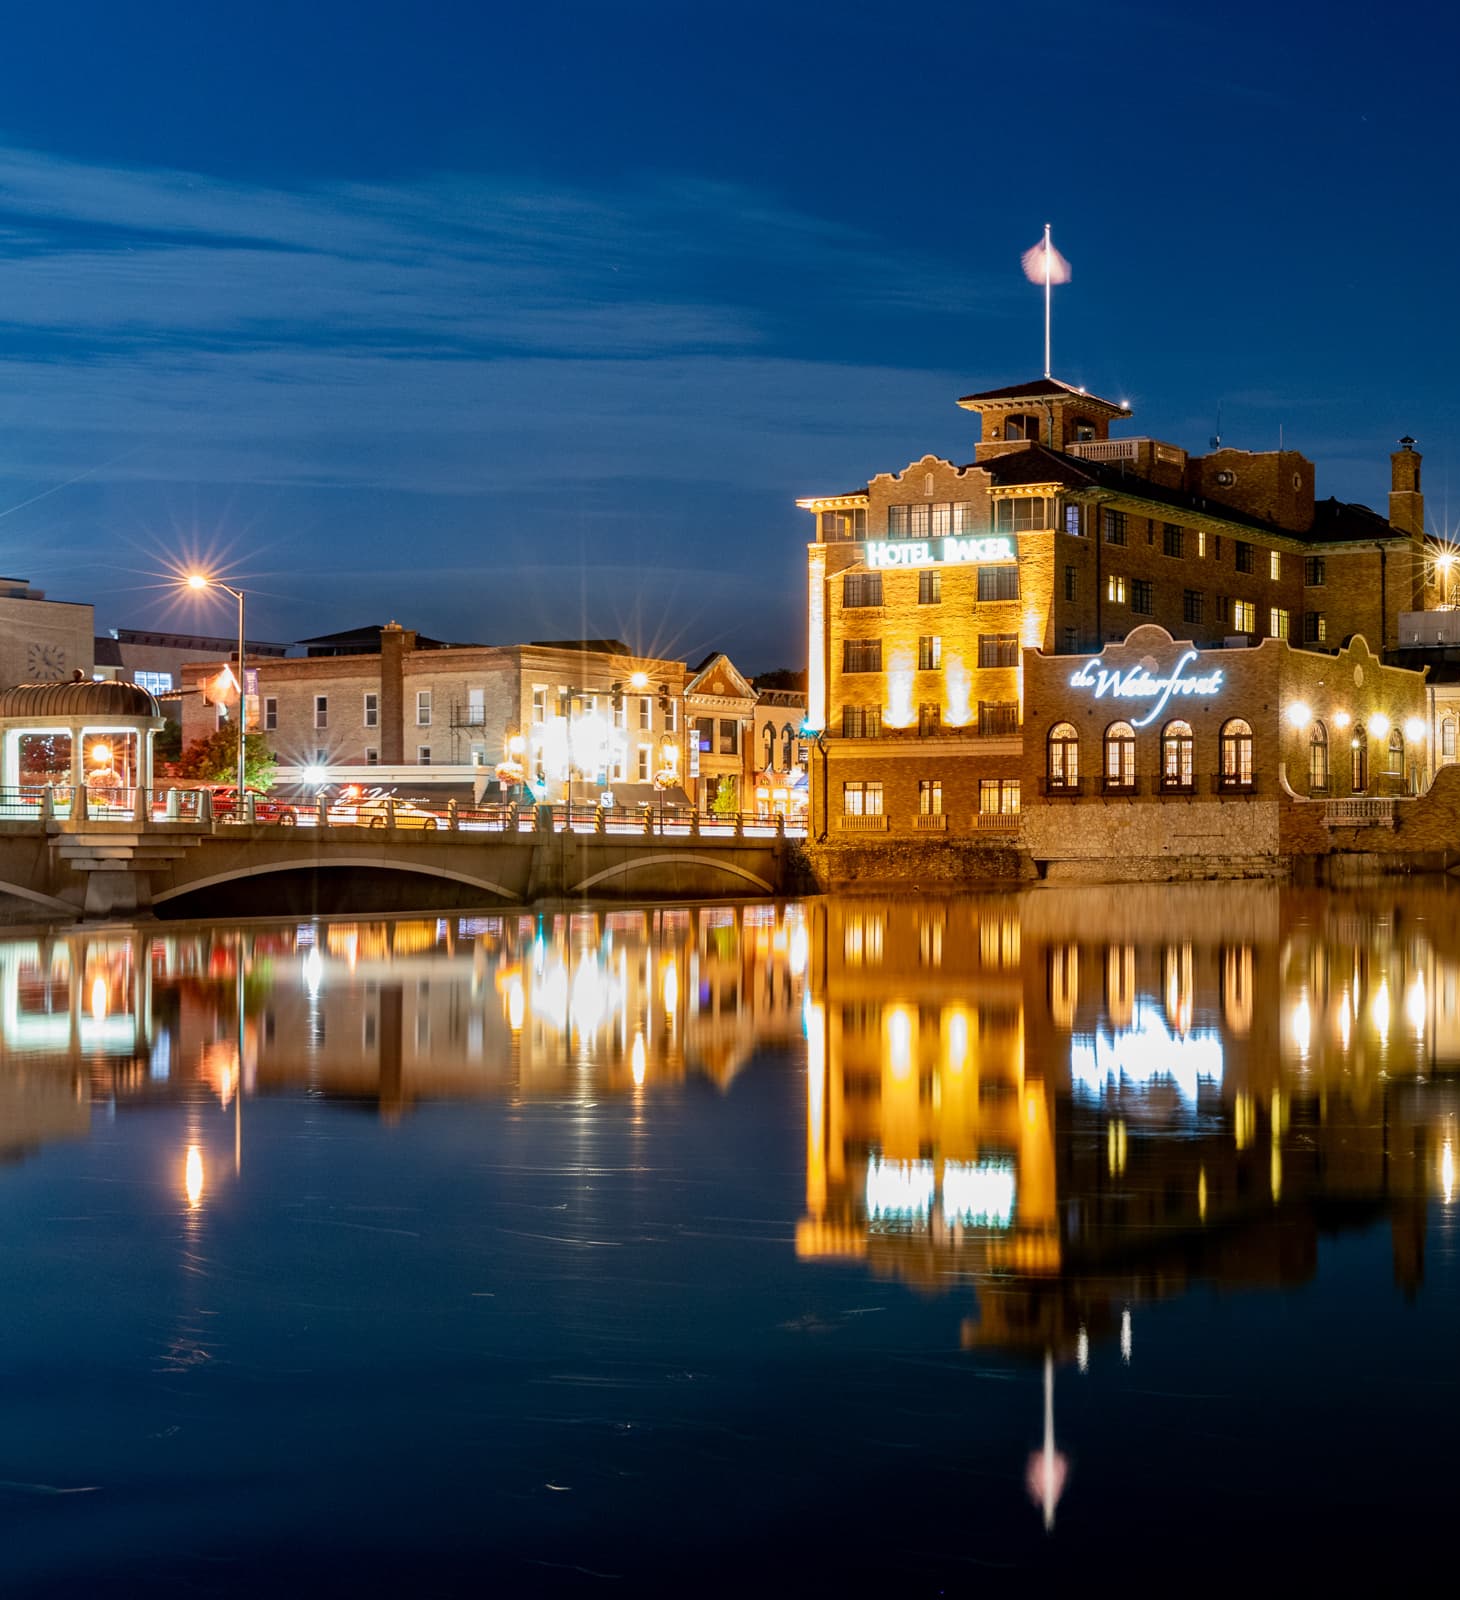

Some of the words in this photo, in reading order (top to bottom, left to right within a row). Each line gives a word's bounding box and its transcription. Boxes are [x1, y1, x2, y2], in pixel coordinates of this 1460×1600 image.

[867, 541, 934, 567] HOTEL
[943, 537, 1014, 562] BAKER
[1070, 659, 1101, 687] the
[1095, 651, 1223, 727] Waterfront
